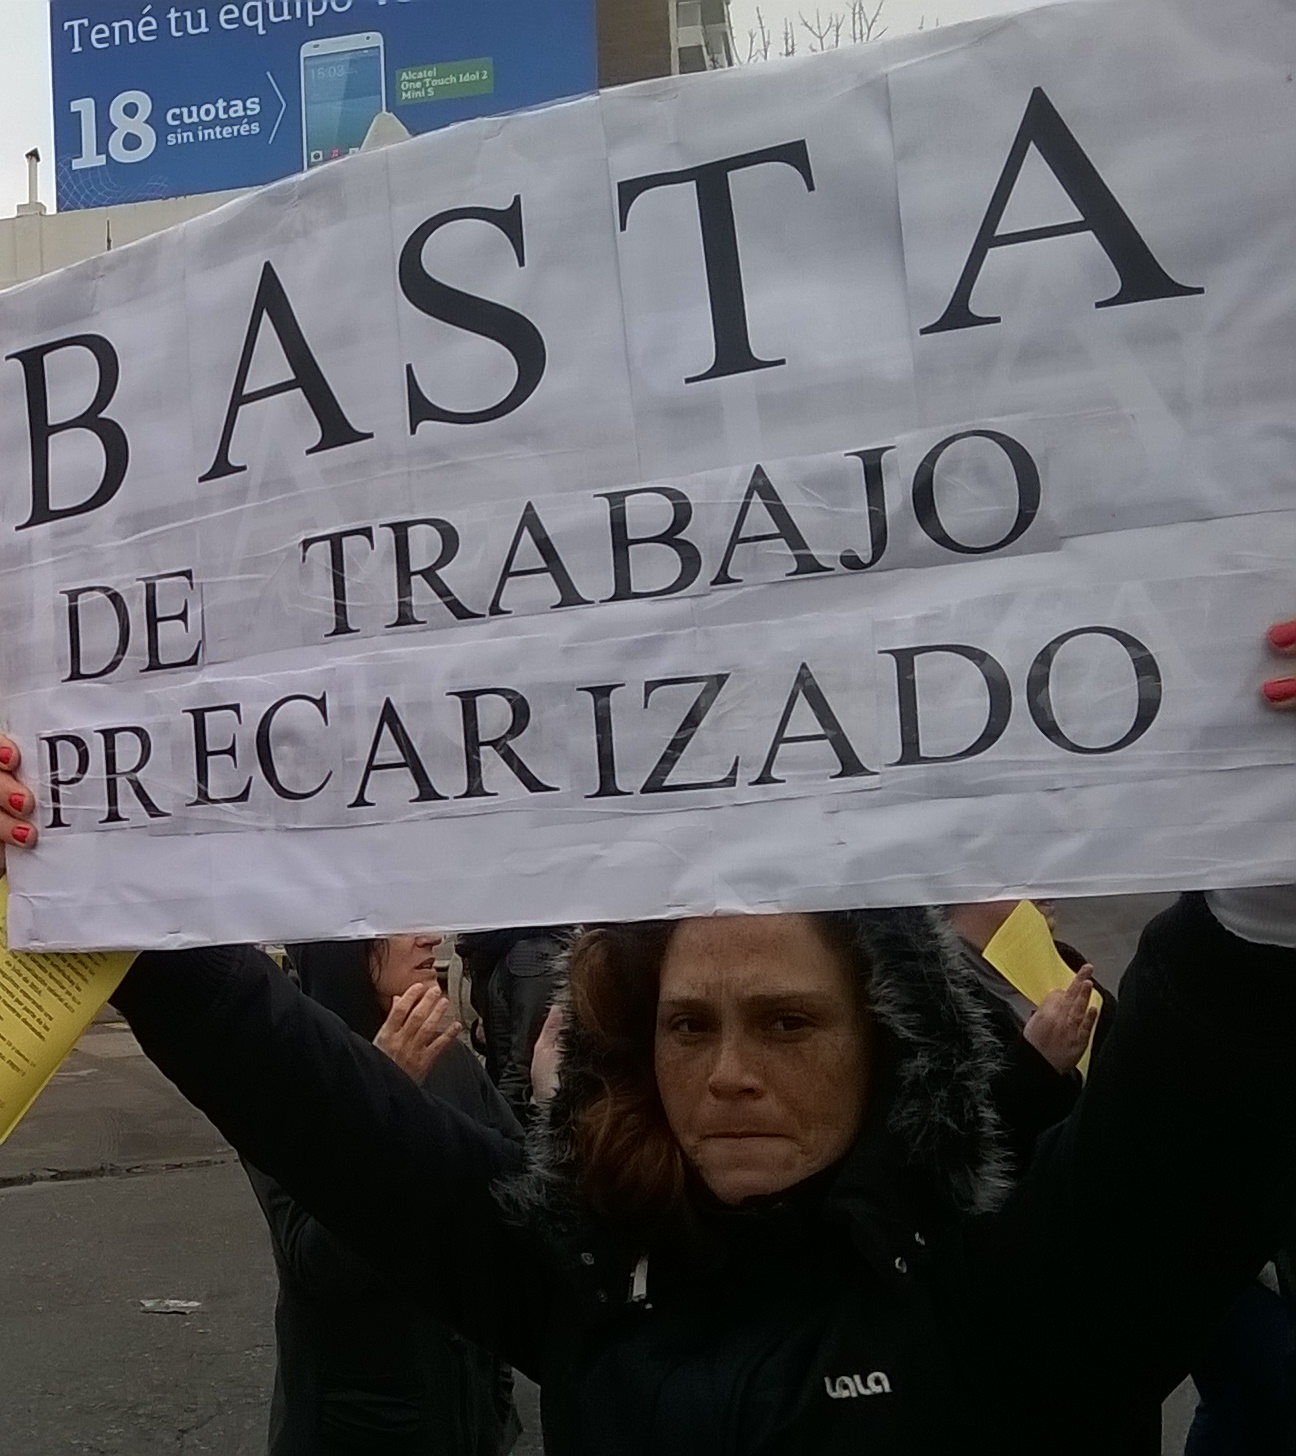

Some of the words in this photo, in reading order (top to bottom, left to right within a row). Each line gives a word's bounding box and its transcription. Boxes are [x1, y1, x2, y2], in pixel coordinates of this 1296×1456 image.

[63, 3, 158, 53] Tené
[166, 6, 209, 38] tu
[218, 0, 354, 35] equipo
[400, 67, 437, 81] Alcatel
[401, 80, 422, 91] One
[424, 74, 457, 87] Touch
[459, 71, 480, 83] Idol
[482, 70, 488, 80] 2
[402, 88, 425, 100] Mini
[70, 90, 157, 170] 18
[166, 96, 262, 126] cuotas
[166, 127, 195, 146] sin
[197, 119, 261, 142] interés
[4, 86, 1205, 532] BASTA
[60, 568, 202, 685] DE
[302, 428, 1044, 640] TRABAJO
[40, 624, 1165, 830] PRECARIZADO
